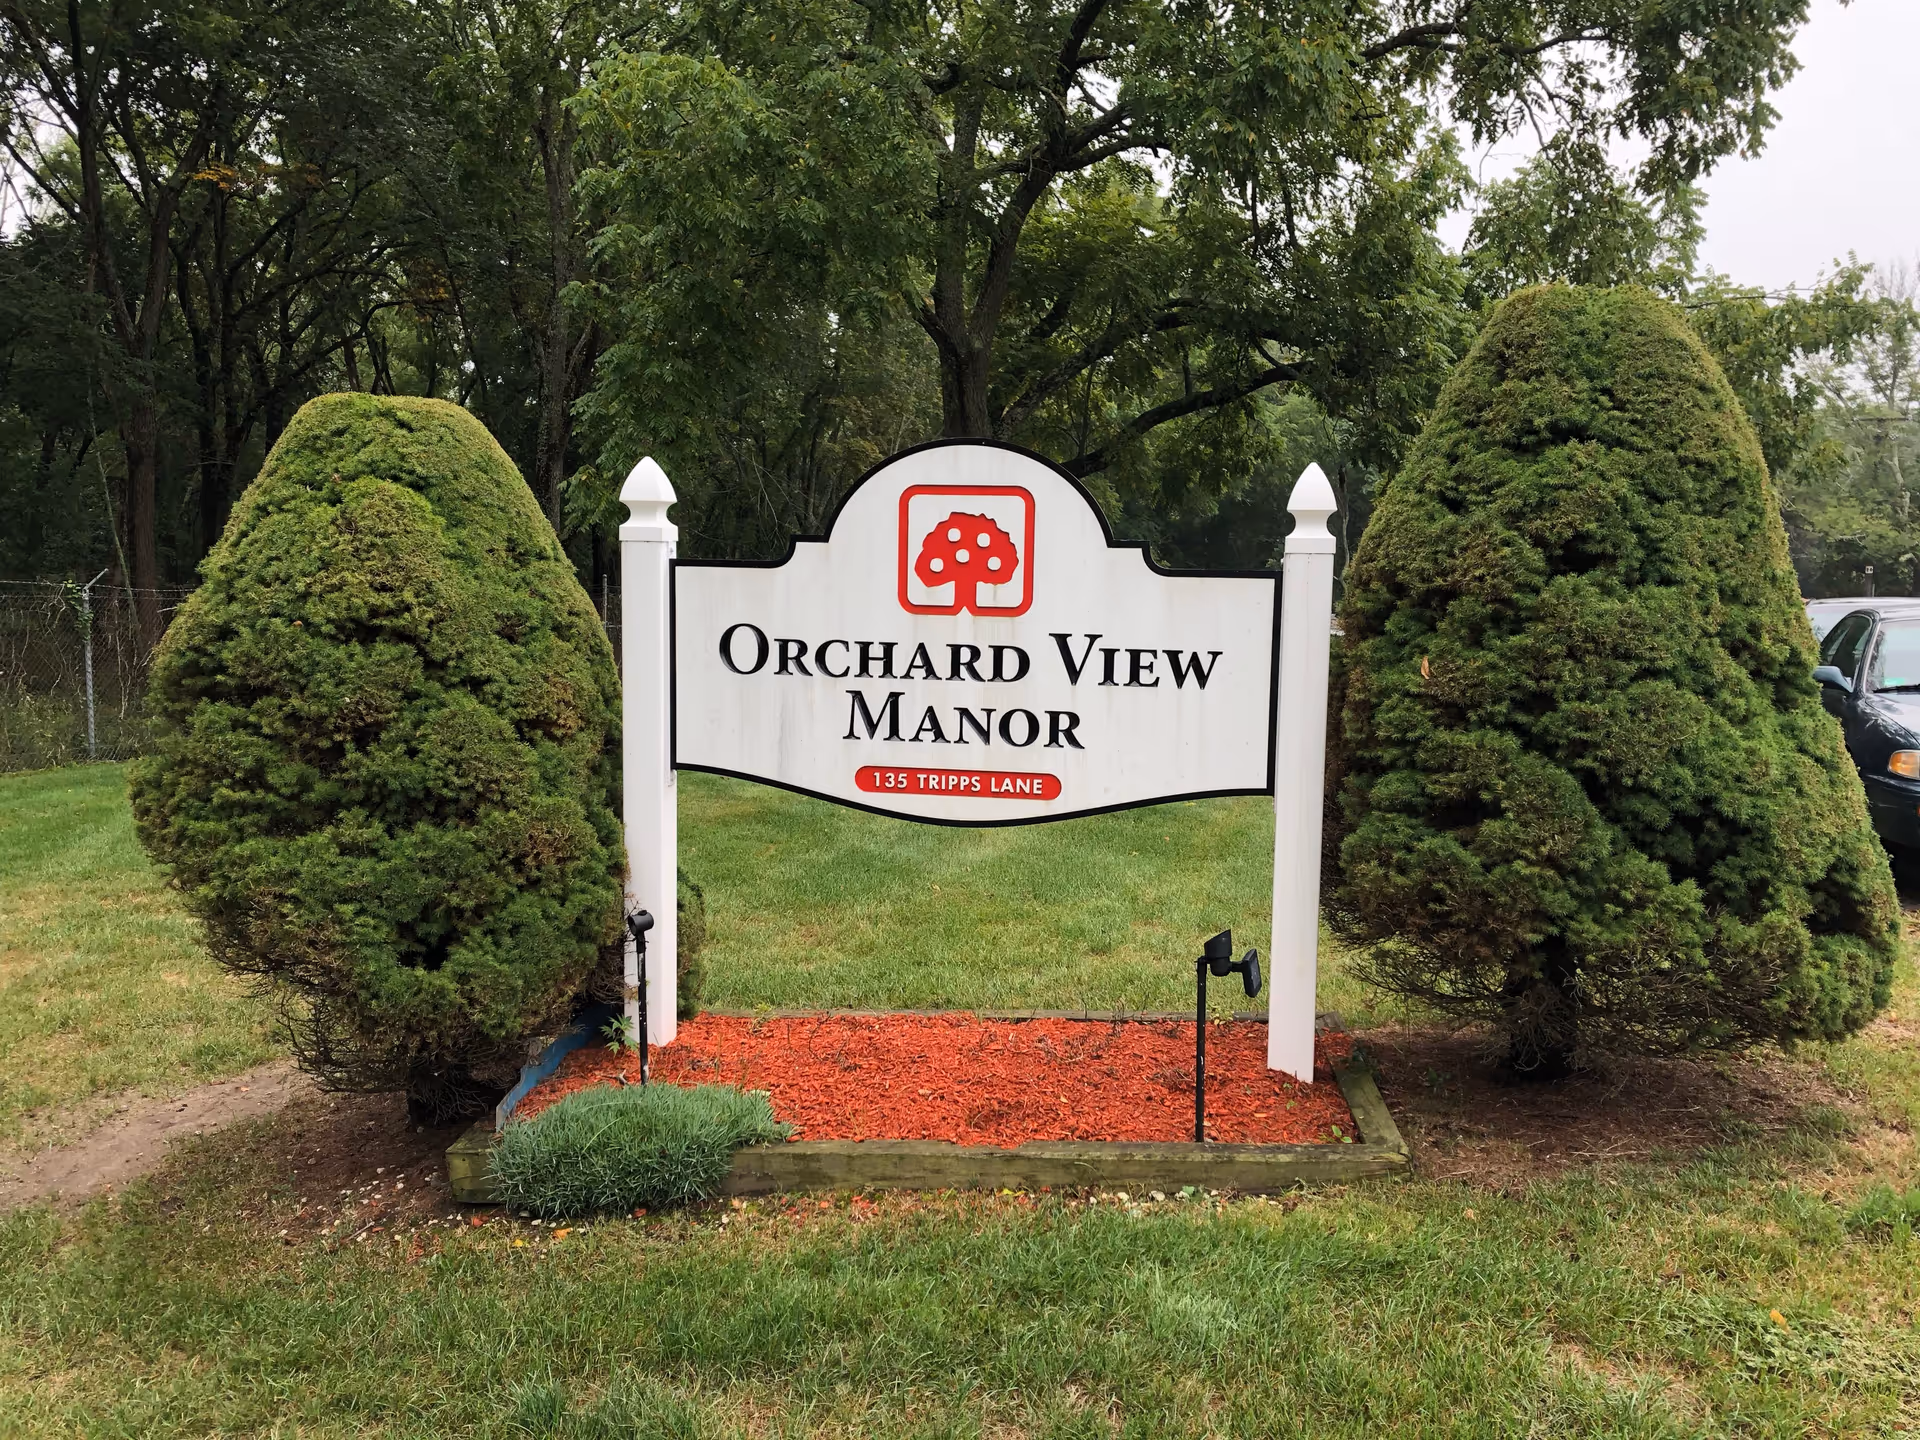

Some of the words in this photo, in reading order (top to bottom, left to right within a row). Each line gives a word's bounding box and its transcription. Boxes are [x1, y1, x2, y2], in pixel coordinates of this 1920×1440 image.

[718, 623, 1031, 683] ORCHARD
[1048, 632, 1224, 690] VIEW
[842, 689, 1086, 750] MANOR
[873, 772, 908, 788] 135
[917, 774, 981, 792] TRIPPS
[990, 777, 1043, 794] LANE
